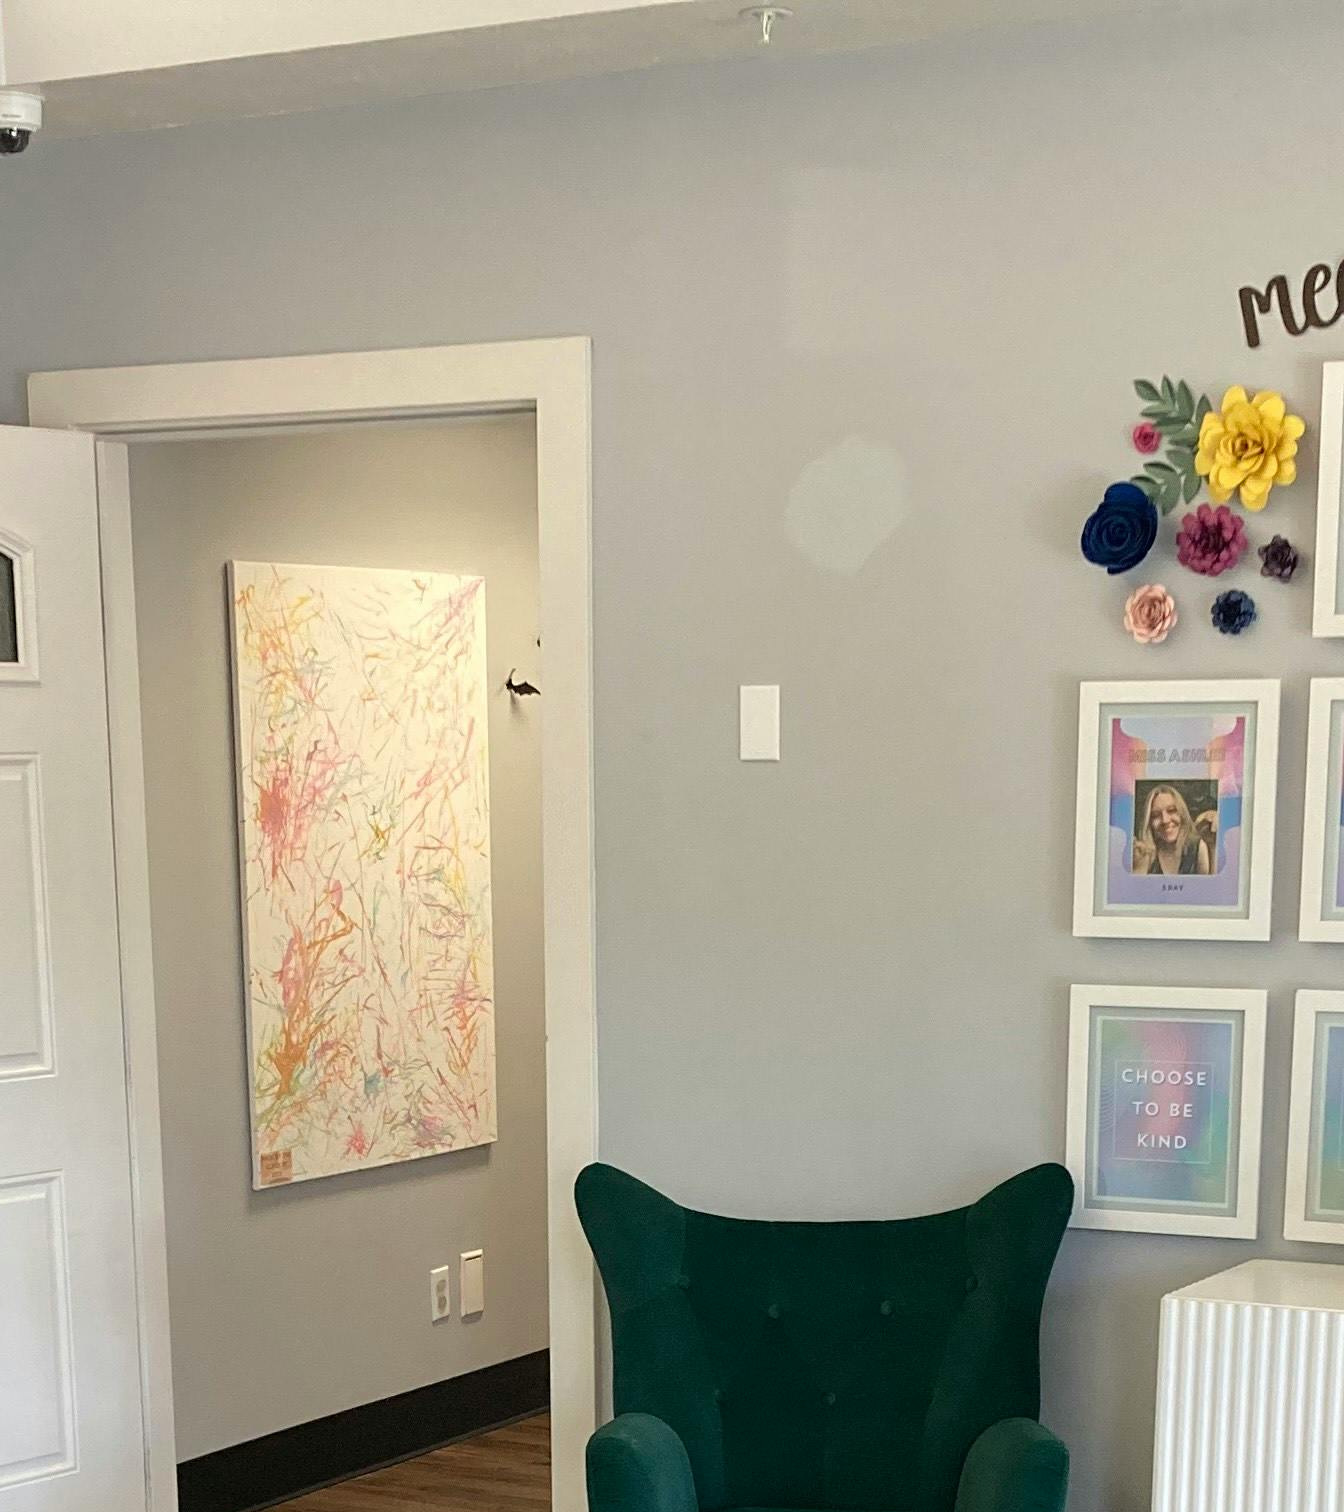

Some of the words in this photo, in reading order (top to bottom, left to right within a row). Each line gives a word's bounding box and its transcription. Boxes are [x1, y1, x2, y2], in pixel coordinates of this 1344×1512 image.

[1121, 1068, 1207, 1086] CHOOSE
[1131, 1101, 1159, 1116] TO
[1169, 1103, 1193, 1118] BE
[1137, 1133, 1187, 1149] KIND
